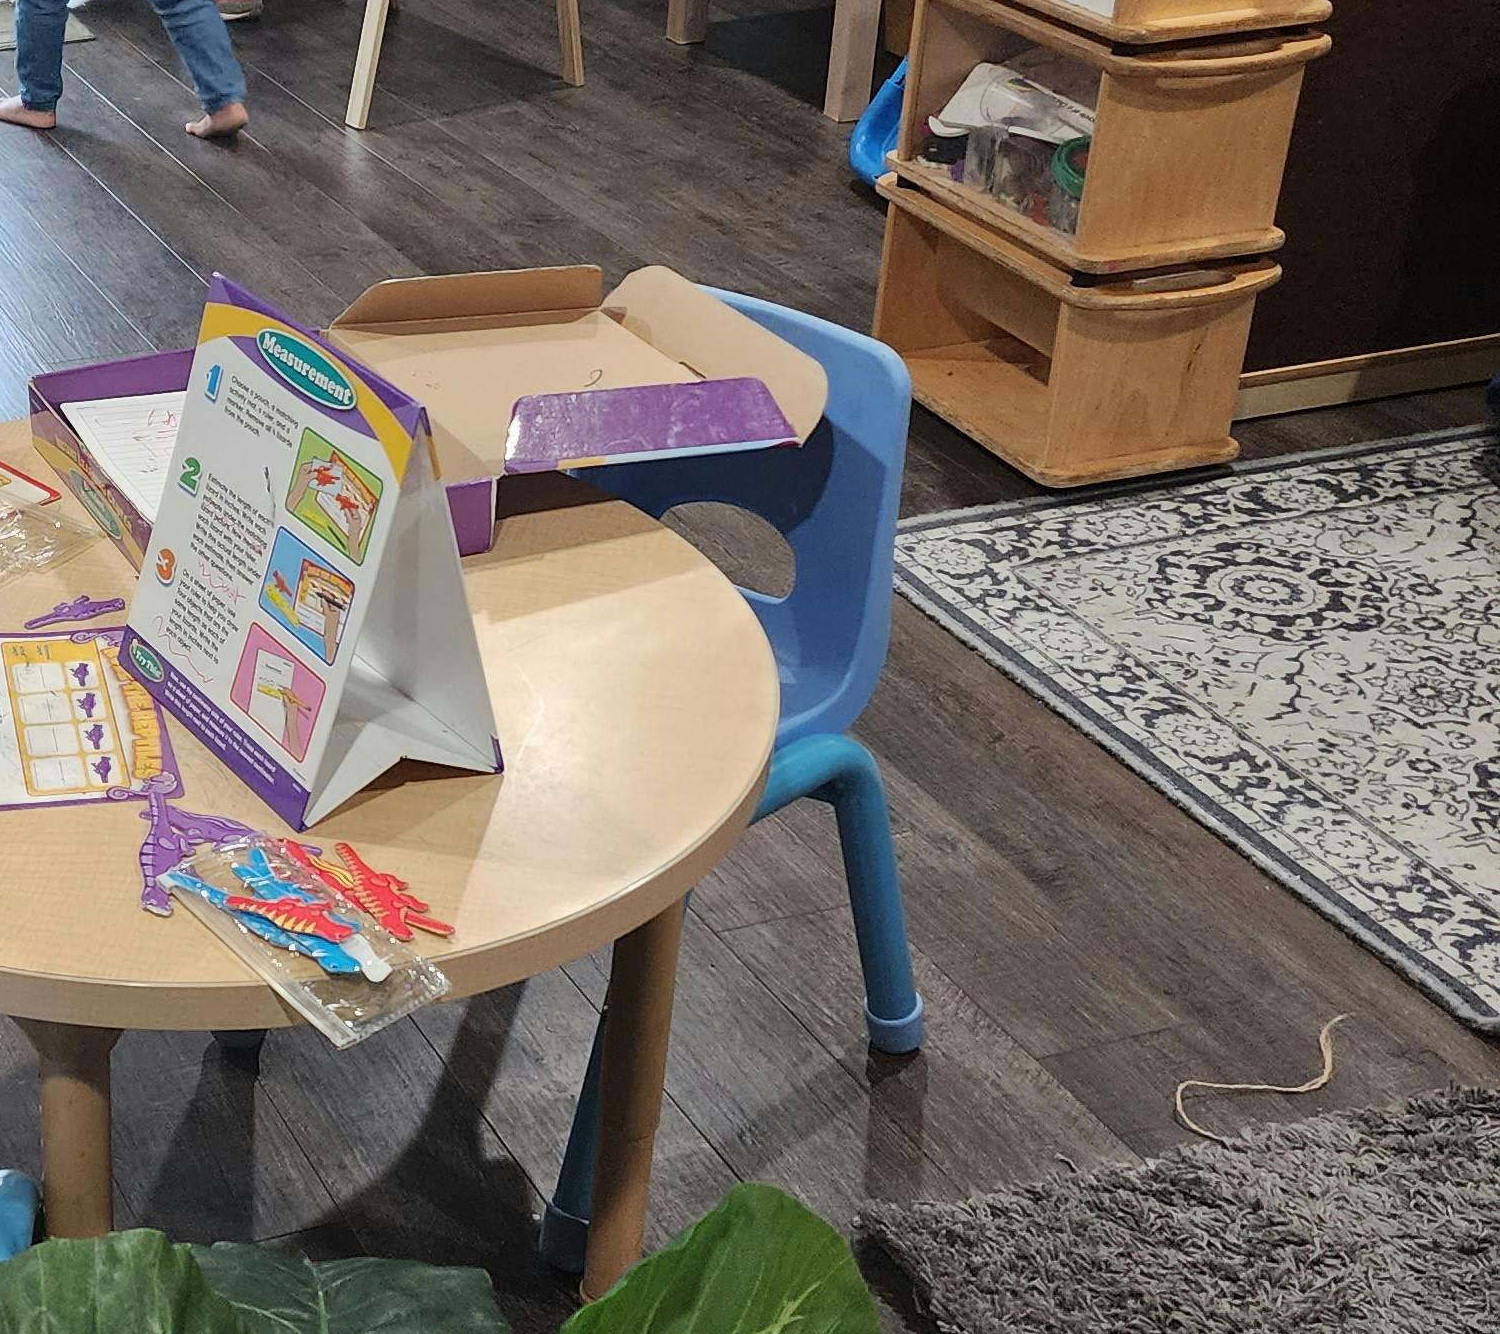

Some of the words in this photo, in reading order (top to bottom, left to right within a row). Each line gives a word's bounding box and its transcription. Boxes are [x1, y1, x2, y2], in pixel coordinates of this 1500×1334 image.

[205, 363, 223, 403] 1
[262, 332, 352, 405] Measurement
[180, 457, 201, 491] 2
[156, 548, 175, 581] 3
